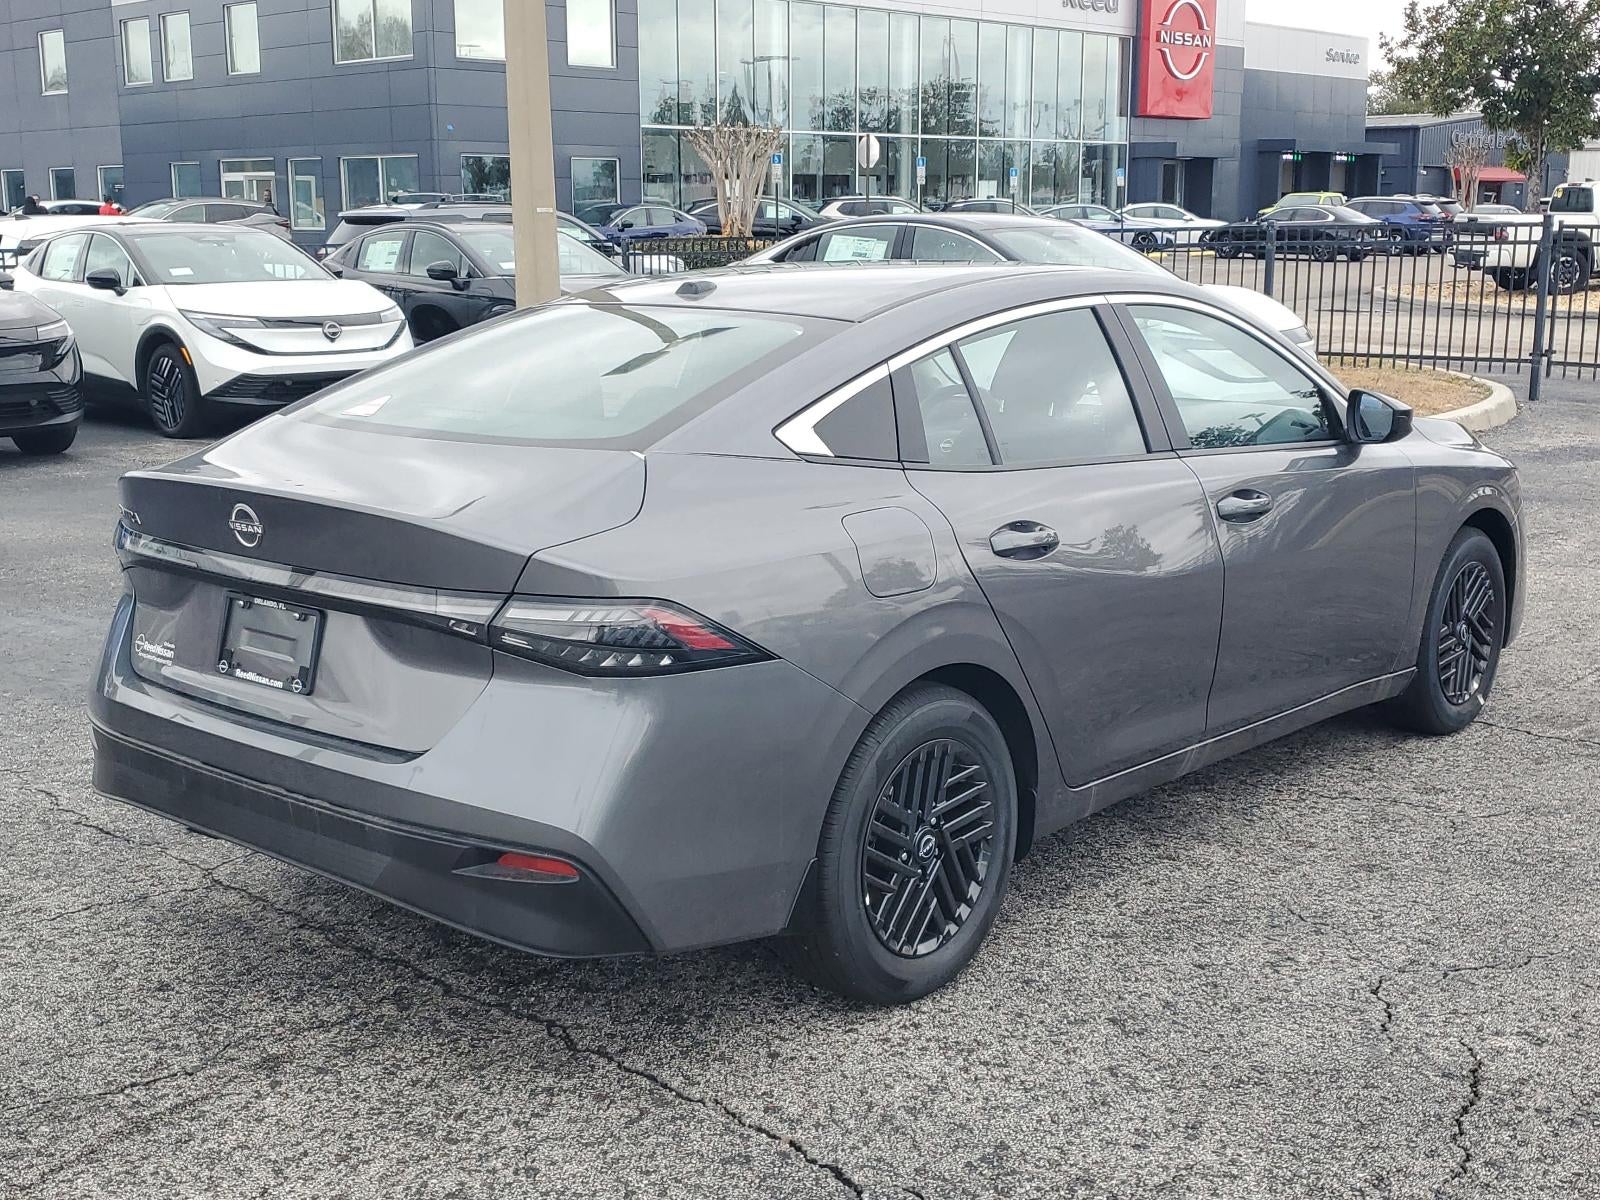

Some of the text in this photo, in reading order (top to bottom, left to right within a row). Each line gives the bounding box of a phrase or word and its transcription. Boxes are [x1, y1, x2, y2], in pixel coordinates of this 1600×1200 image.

[1160, 29, 1212, 48] NISSAN
[1325, 47, 1360, 65] Service
[229, 520, 263, 534] NISSAN
[235, 668, 284, 689] ReedNissan.com
